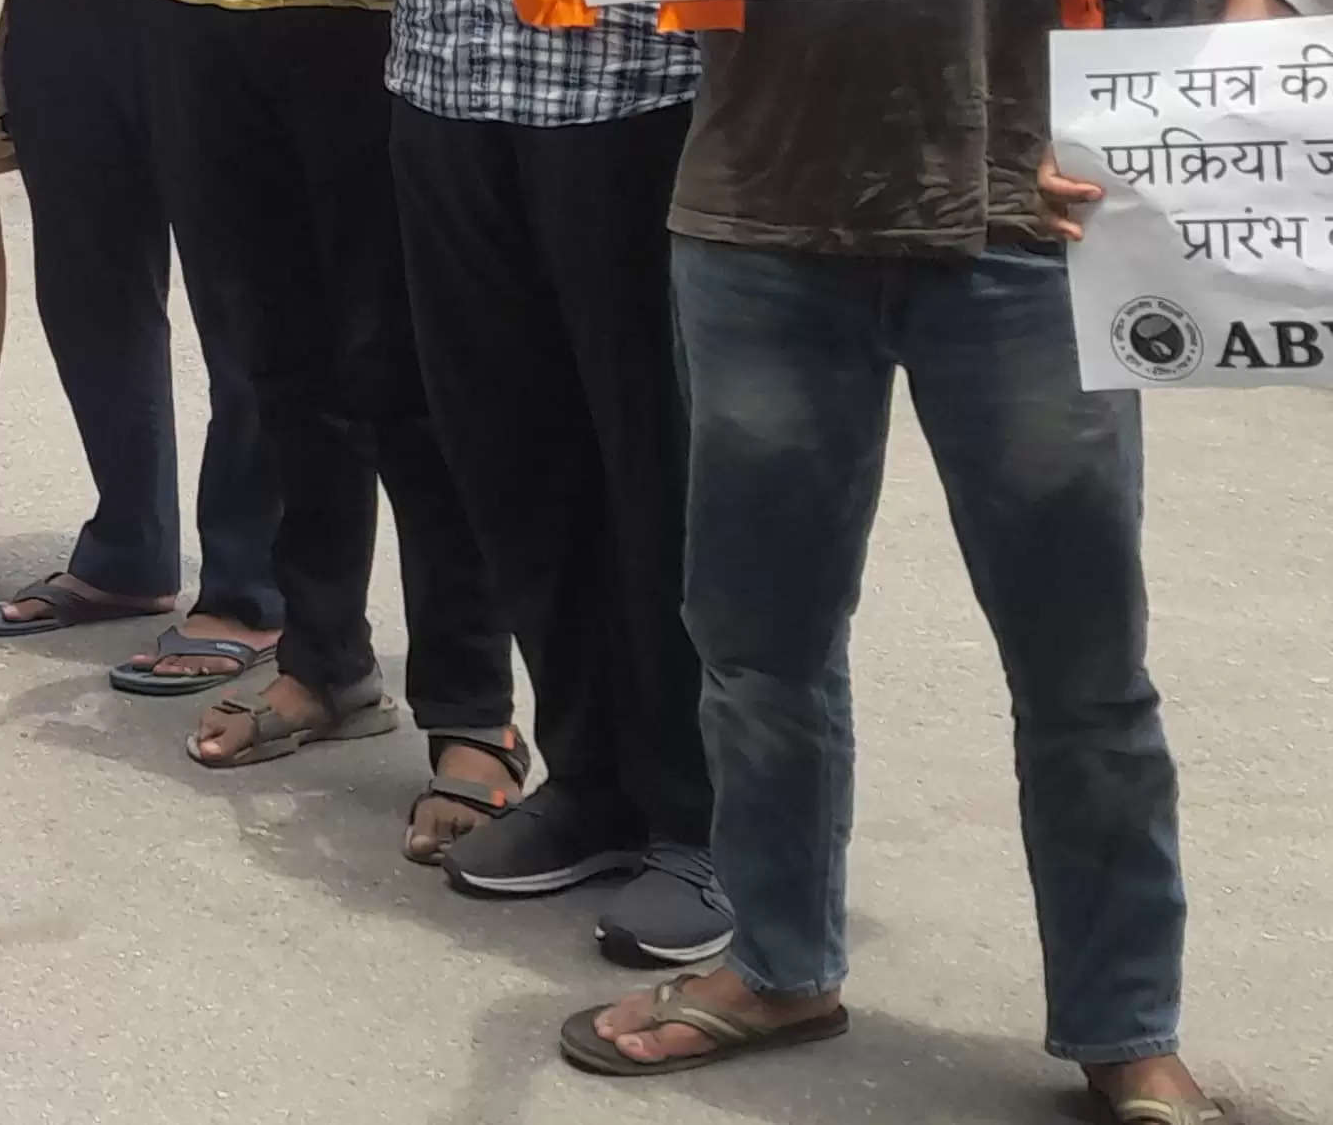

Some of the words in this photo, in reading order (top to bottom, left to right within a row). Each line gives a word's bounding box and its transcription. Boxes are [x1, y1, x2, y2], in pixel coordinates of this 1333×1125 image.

[1085, 71, 1160, 117] नए
[1174, 65, 1263, 107] सत्र
[1176, 208, 1309, 259] प्रारंभ
